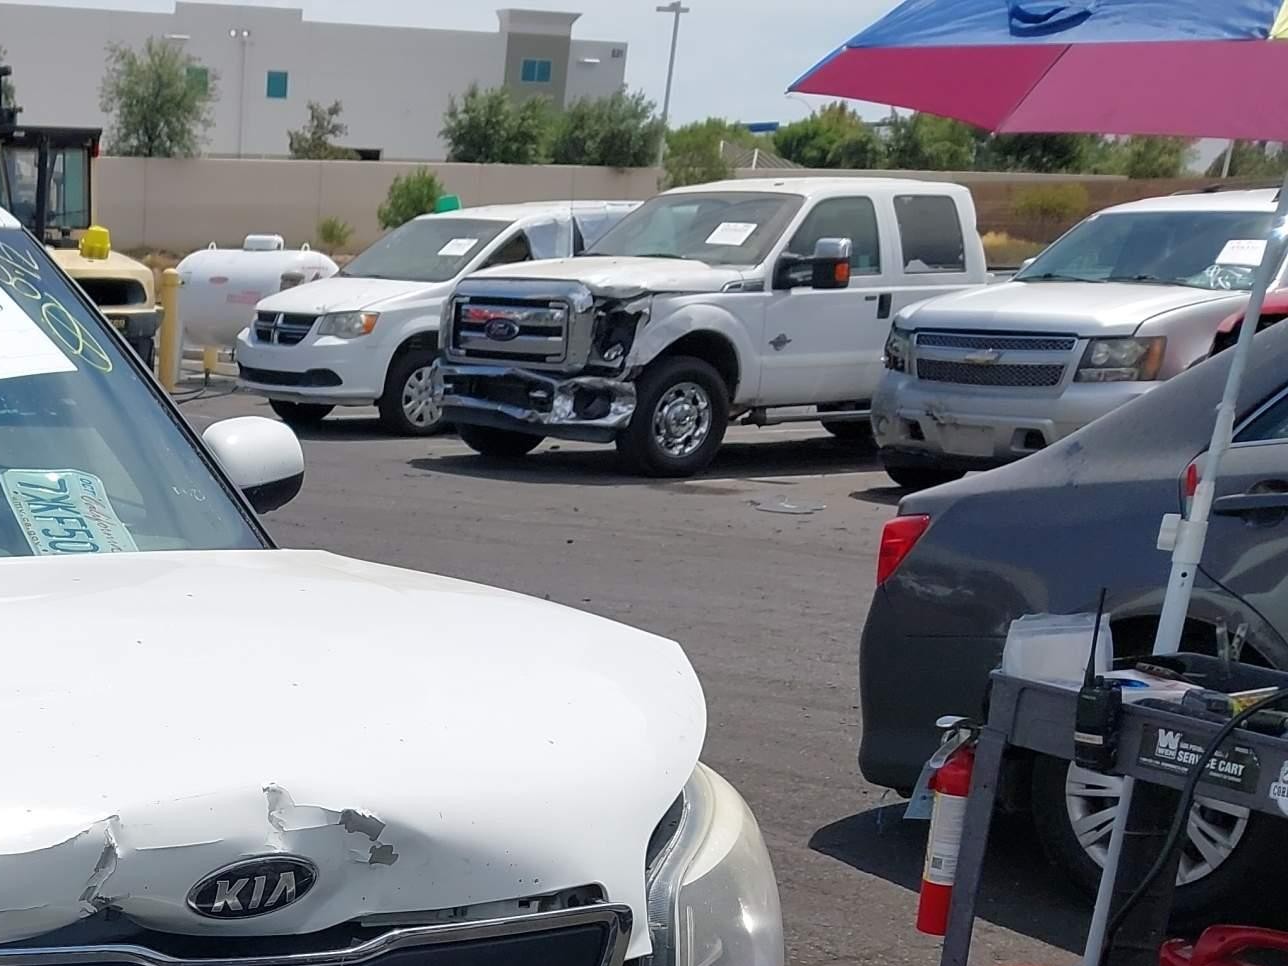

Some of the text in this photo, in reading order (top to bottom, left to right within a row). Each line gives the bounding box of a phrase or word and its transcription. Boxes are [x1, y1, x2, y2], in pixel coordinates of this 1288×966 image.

[1177, 750, 1217, 769] SERVE
[1218, 760, 1245, 777] CART
[211, 871, 296, 913] KIA
